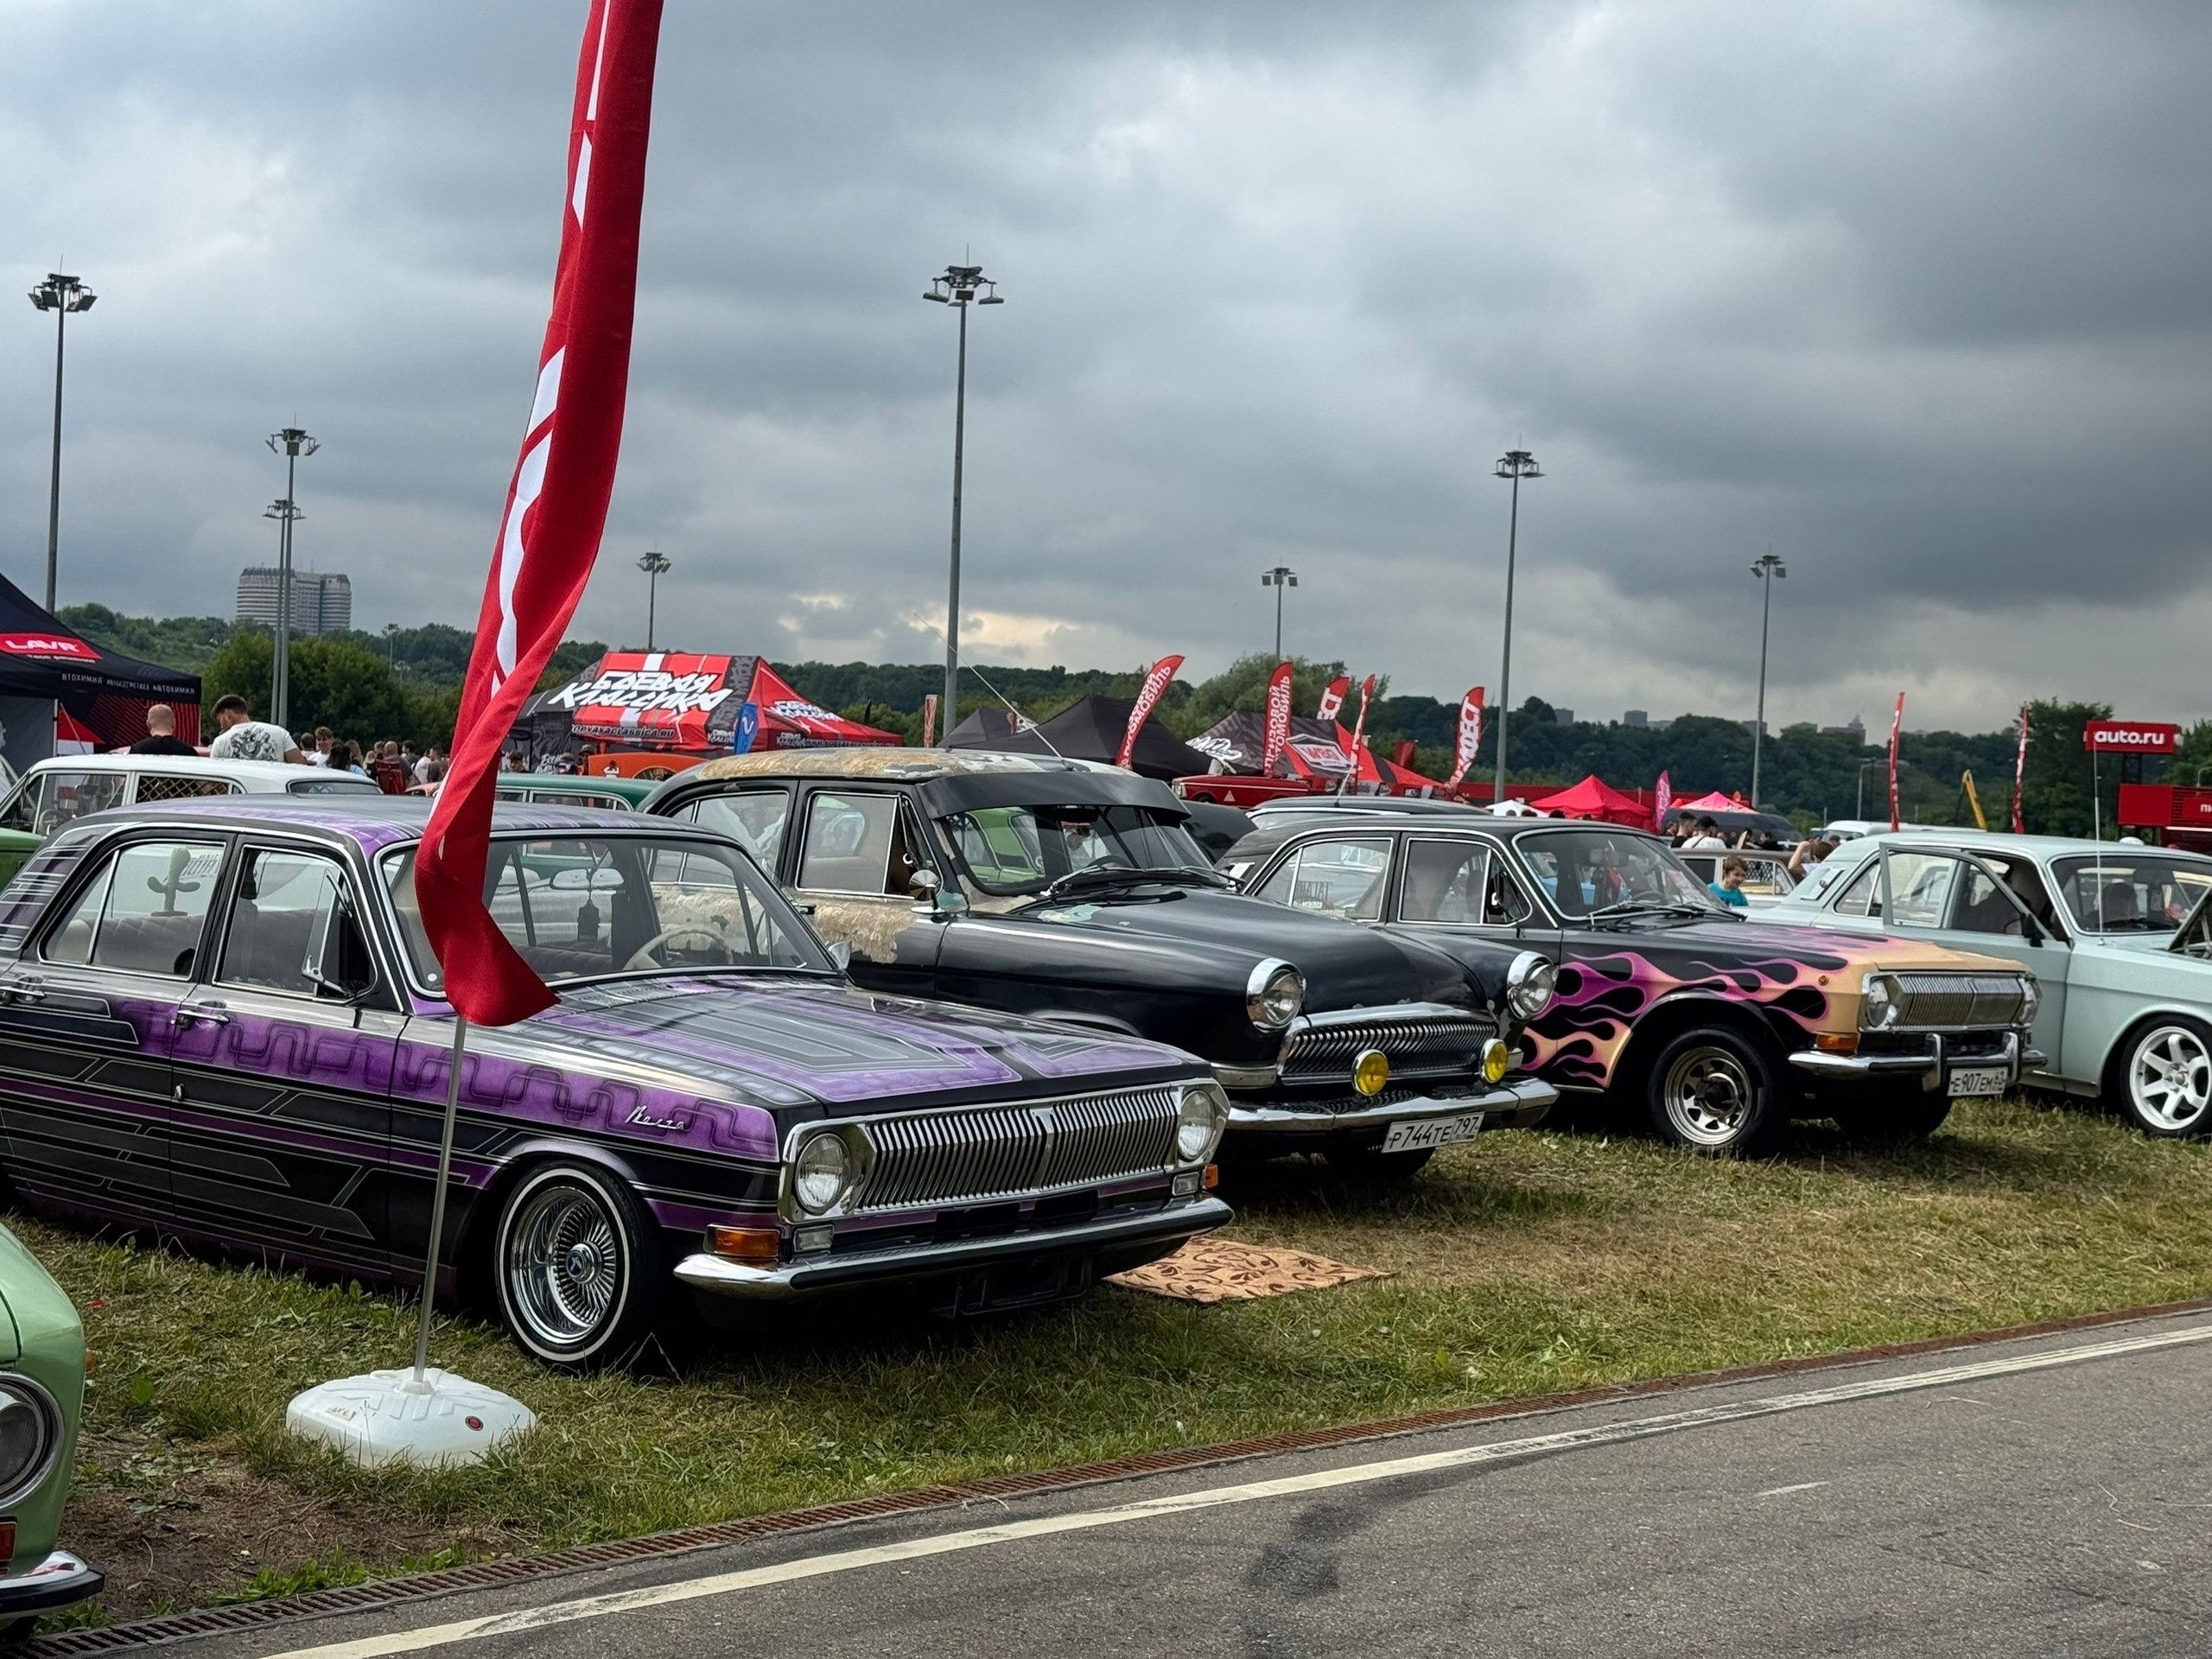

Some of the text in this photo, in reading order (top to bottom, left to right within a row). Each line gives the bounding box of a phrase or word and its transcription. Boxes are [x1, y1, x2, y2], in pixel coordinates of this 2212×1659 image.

[4, 639, 80, 653] LAVR
[592, 671, 718, 692] БОЕВАЯ
[548, 682, 734, 713] КЛАССИКА
[2094, 730, 2164, 745] auto.ru
[1454, 1116, 1479, 1135] 797
